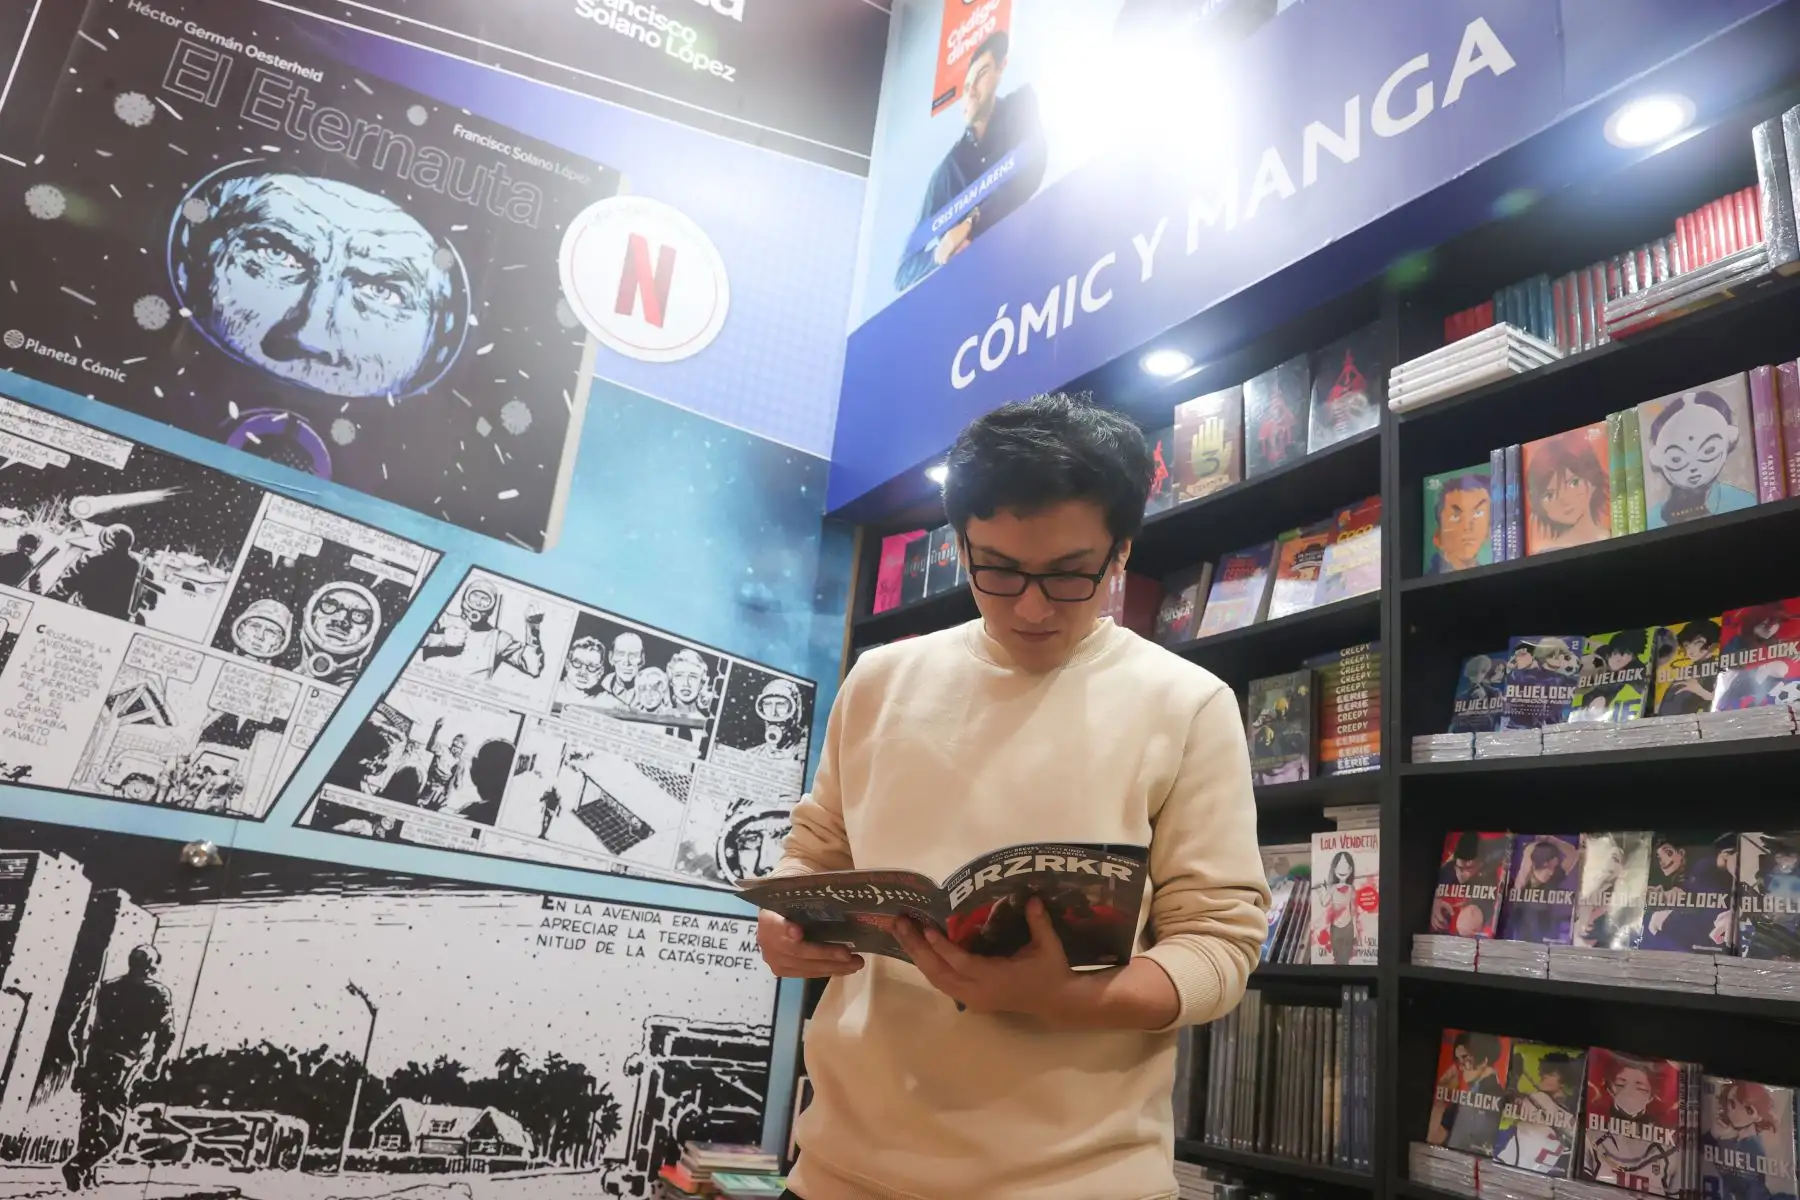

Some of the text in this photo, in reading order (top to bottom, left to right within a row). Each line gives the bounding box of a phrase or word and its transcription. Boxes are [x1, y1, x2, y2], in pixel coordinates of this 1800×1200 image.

[127, 0, 324, 83] Héctor Germán Oesterheld
[574, 0, 662, 48] Solano
[664, 35, 737, 83] López
[162, 38, 544, 228] El Eternauta
[452, 123, 592, 185] Francisco Solano López
[932, 155, 1015, 232] CRISTIAN ARENS
[949, 16, 1517, 390] CÓMIC Y MANGA
[614, 232, 677, 329] N
[25, 338, 127, 383] Planeta Cómic
[1340, 643, 1371, 657] CREEPY
[1340, 654, 1370, 667] CREEPY
[1720, 641, 1800, 669] BLUELOCK
[1340, 663, 1370, 675] CREEPY
[1341, 671, 1371, 684] CREEPY
[1579, 667, 1645, 689] BLUELOCK
[1658, 661, 1719, 683] BLUELOC
[1336, 681, 1366, 694] CREEPY
[1506, 684, 1576, 700] BLUELOCK
[1337, 709, 1368, 722] CREEPY
[1455, 697, 1502, 712] BLUELOC
[1337, 721, 1368, 735] CREEPY
[1337, 756, 1370, 770] EERIE
[1320, 833, 1378, 851] LOLA VENDETTA
[950, 855, 1133, 911] BRZRKR
[1438, 884, 1497, 900] BLUELOCK
[1509, 888, 1575, 905] BLUELOCK
[1649, 892, 1729, 909] BLUELOCK
[541, 894, 567, 913] EN
[574, 902, 593, 917] LA
[602, 907, 662, 925] AVENIDA
[672, 914, 700, 930] ERA
[707, 919, 739, 934] MÁS
[539, 916, 761, 954] APRECIAR LA TERRIBLE MA
[536, 934, 757, 972] NITUD DE LA CATÁSTROFE.
[1436, 1086, 1500, 1112] BLUELOCK
[1503, 1103, 1575, 1129] BLUELOCK
[1588, 1112, 1677, 1147] BLUELOCK
[1703, 1144, 1794, 1179] BLUELOCK
